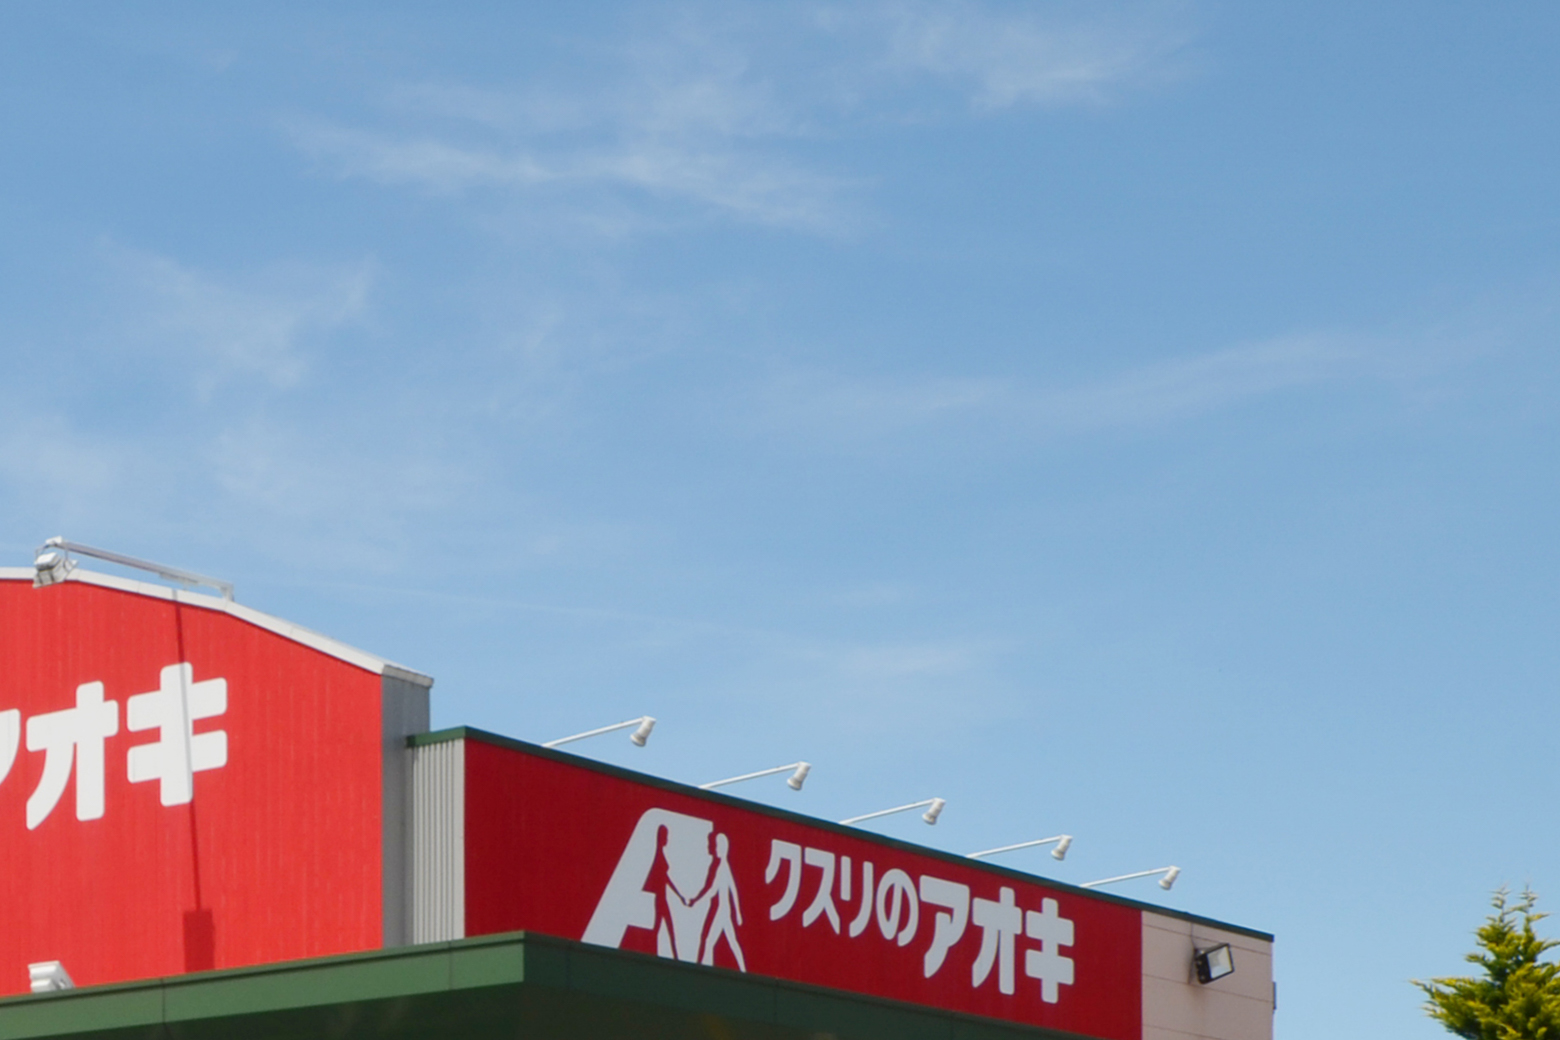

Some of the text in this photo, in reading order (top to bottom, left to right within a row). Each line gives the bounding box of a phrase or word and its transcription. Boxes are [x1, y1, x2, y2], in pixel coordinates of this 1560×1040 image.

[765, 838, 1075, 1005] クスリのアオキ
